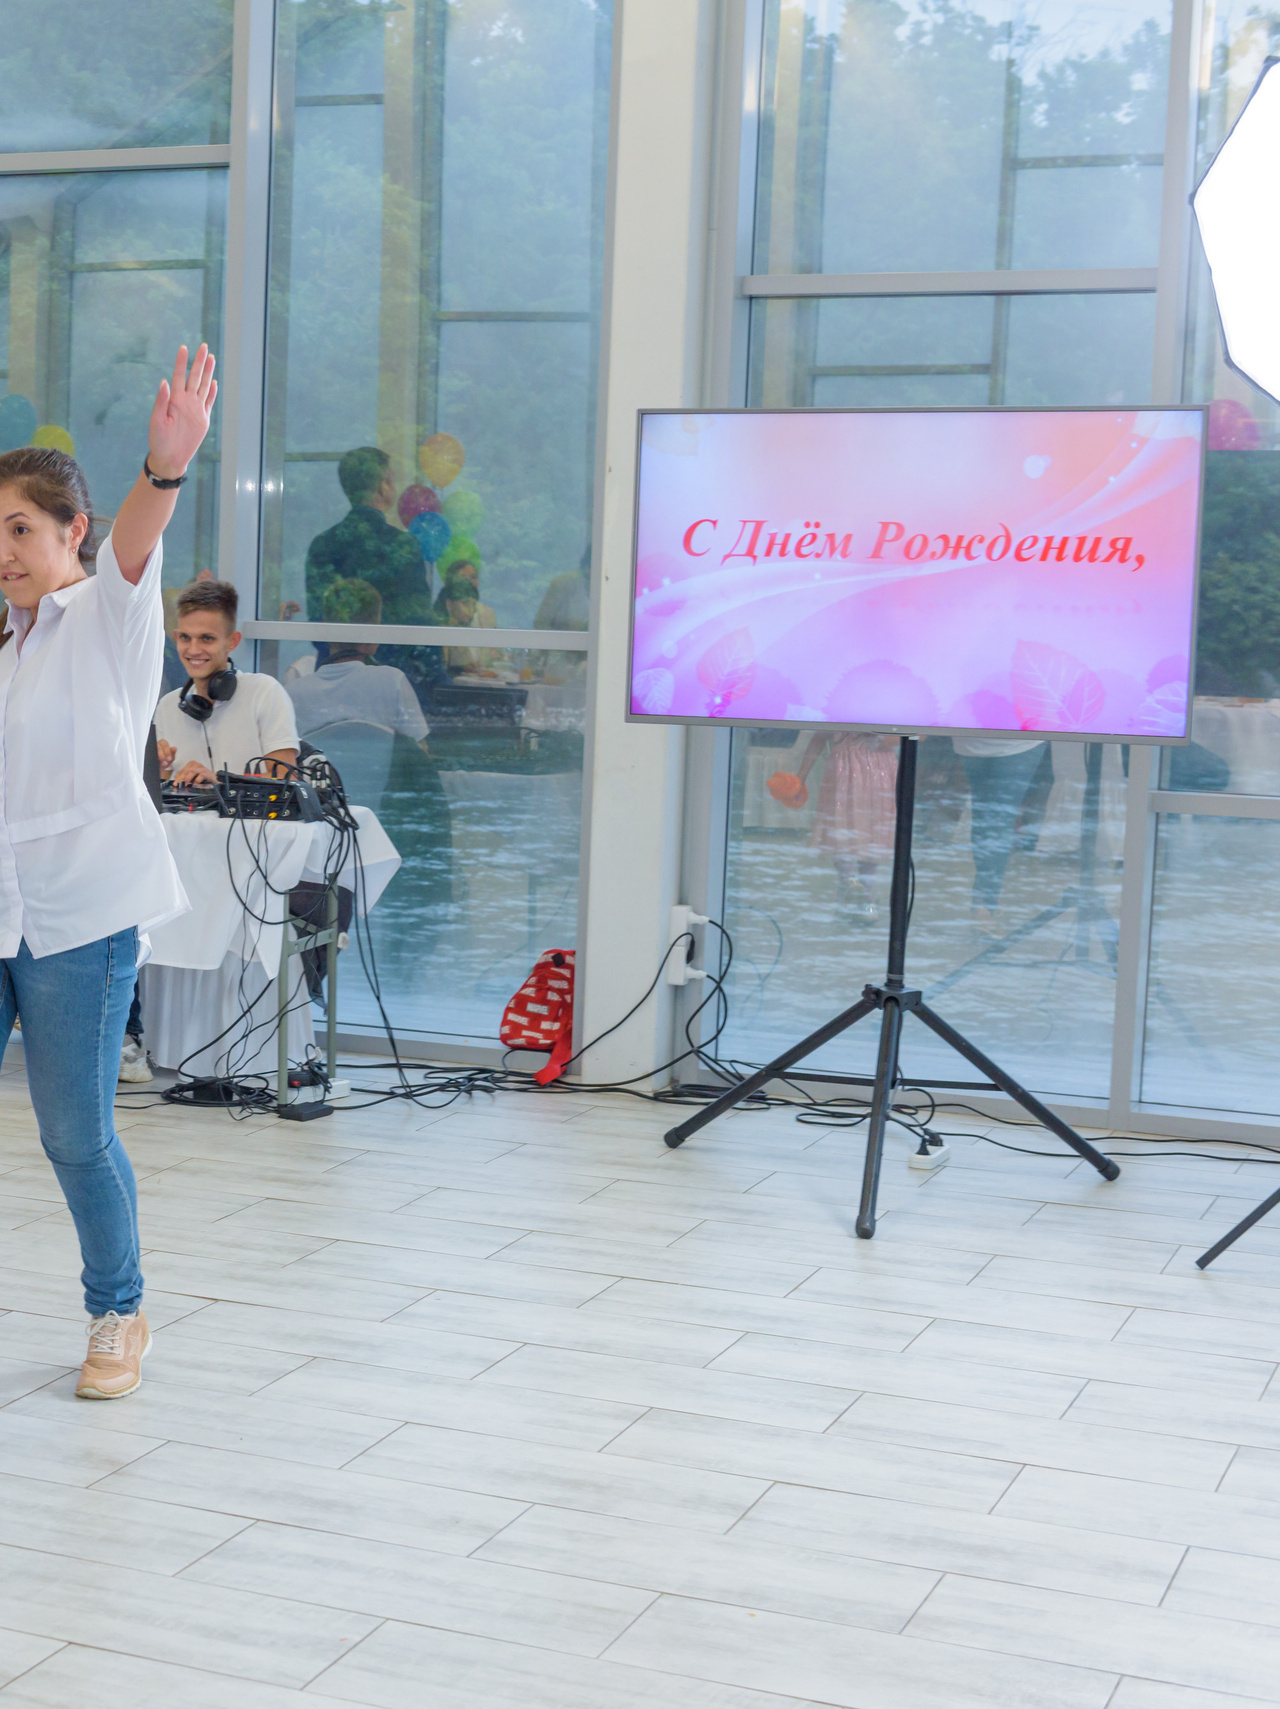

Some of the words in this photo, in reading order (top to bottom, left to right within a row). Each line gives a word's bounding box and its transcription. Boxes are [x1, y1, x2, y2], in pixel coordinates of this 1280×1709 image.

[682, 518, 719, 557] С
[720, 519, 852, 566] Днём
[868, 521, 1146, 572] Рождения,
